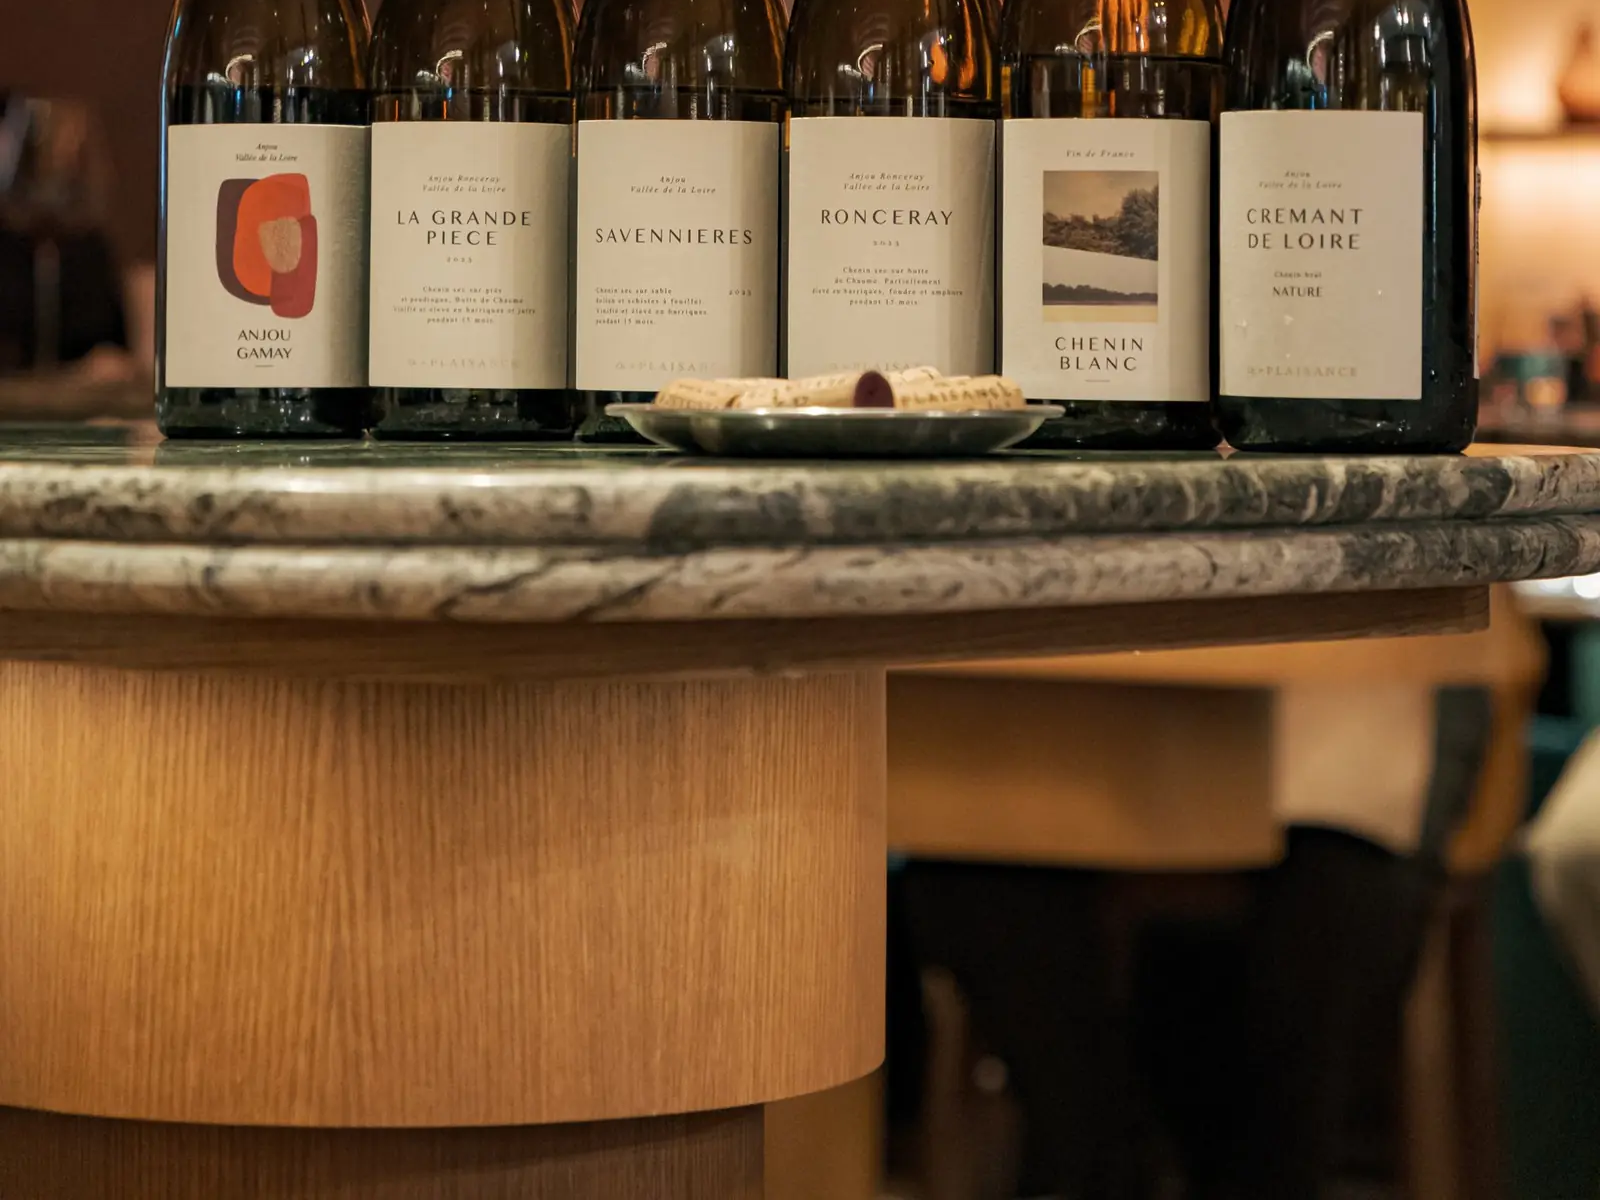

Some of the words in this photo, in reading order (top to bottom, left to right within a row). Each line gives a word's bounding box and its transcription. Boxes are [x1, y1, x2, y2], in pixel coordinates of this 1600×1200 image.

[255, 143, 278, 152] Anjou
[258, 153, 267, 161] de
[269, 153, 277, 161] la
[279, 153, 298, 161] Loire
[1065, 149, 1081, 158] Vin
[1085, 149, 1096, 158] de
[1100, 149, 1136, 158] France
[428, 174, 453, 183] Anjou
[457, 174, 501, 184] Ronceray
[850, 173, 875, 181] Anjou
[880, 173, 925, 182] Ronceray
[1284, 170, 1310, 178] Anjou
[660, 176, 686, 184] Anjou
[1288, 181, 1298, 189] de
[454, 184, 465, 192] de
[468, 184, 478, 192] la
[481, 185, 507, 193] Loire
[691, 186, 716, 194] Loire
[876, 183, 887, 191] de
[891, 183, 901, 191] la
[905, 183, 930, 191] Loire
[397, 210, 420, 225] LA
[431, 209, 532, 227] GRANDE
[821, 209, 953, 226] RONCERAY
[1246, 208, 1363, 224] CREMANT
[426, 230, 499, 246] PIECE
[595, 228, 753, 245] SAVENNIERES
[1248, 233, 1272, 249] DE
[1284, 232, 1361, 250] LOIRE
[1272, 286, 1324, 298] NATURE
[237, 328, 292, 341] ANJOU
[1055, 336, 1143, 351] CHENIN
[236, 346, 293, 360] GAMAY
[1060, 356, 1137, 371] BLANC
